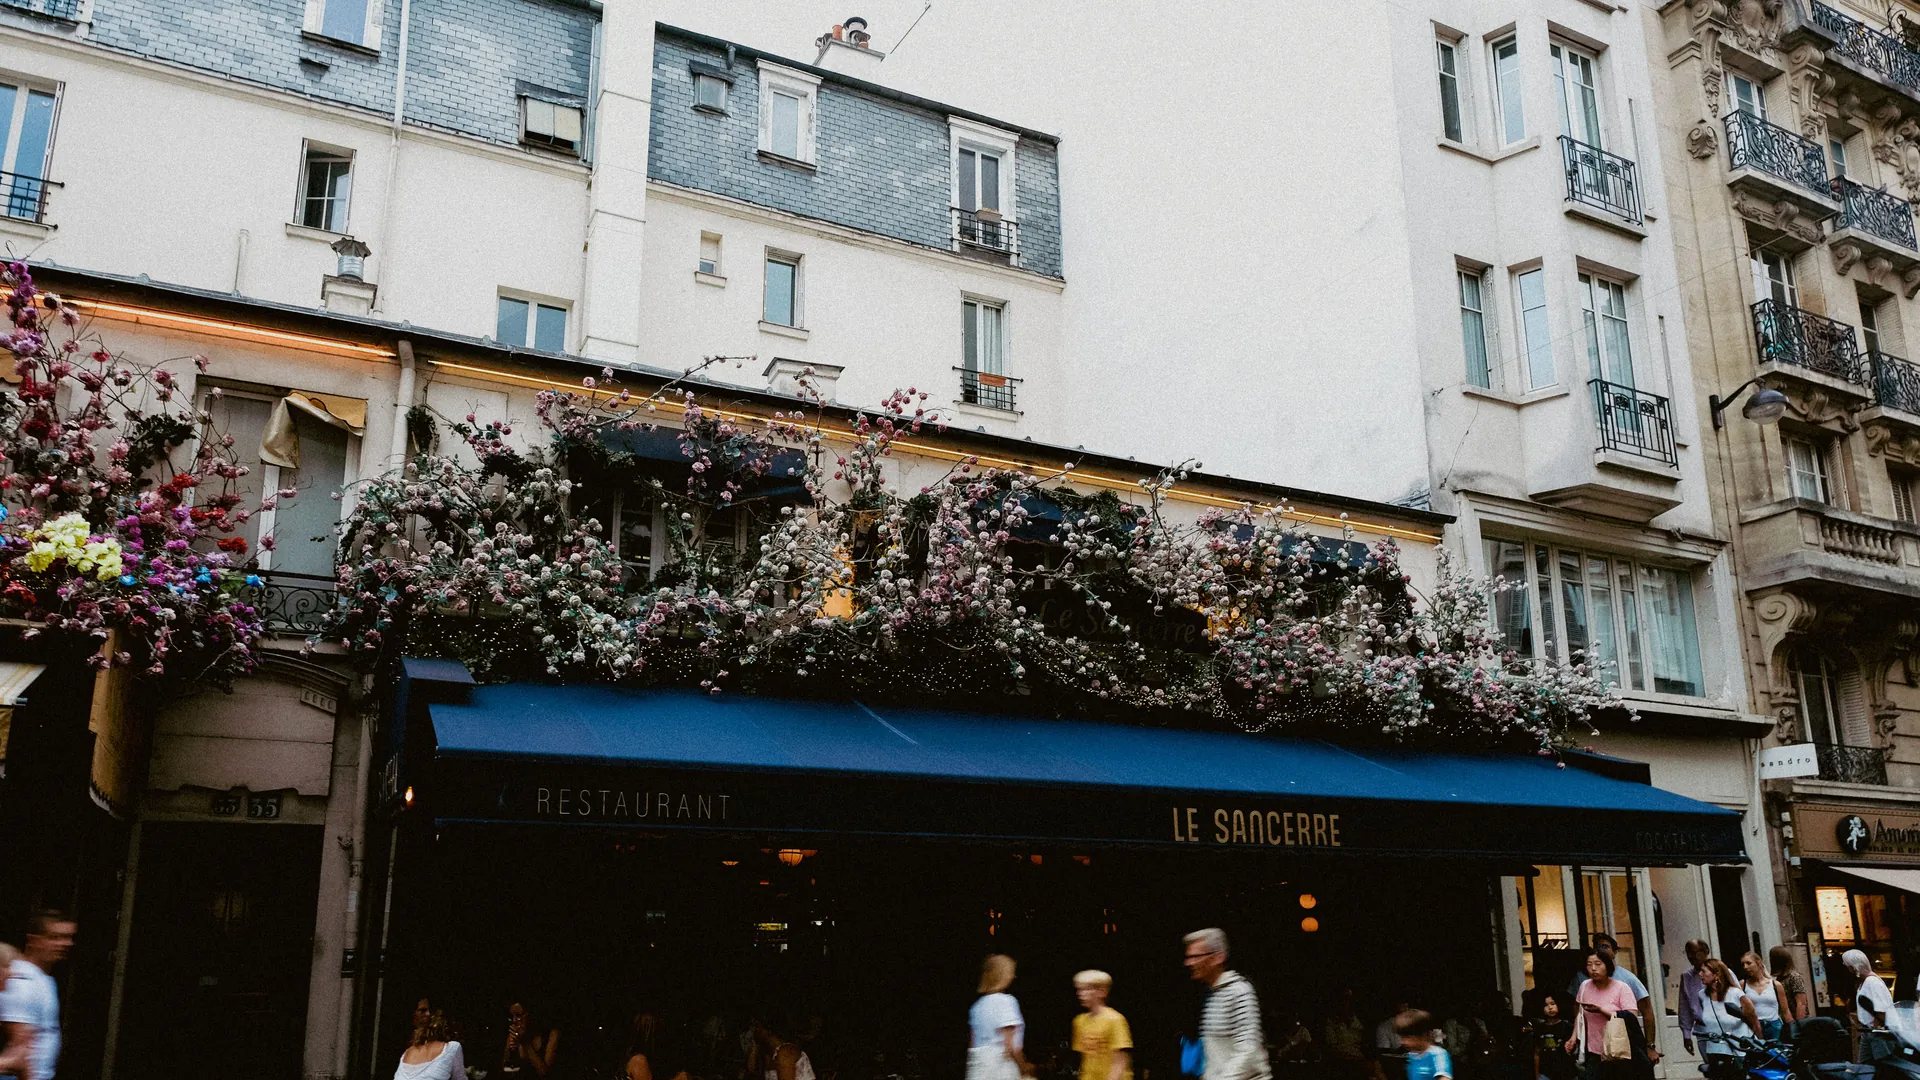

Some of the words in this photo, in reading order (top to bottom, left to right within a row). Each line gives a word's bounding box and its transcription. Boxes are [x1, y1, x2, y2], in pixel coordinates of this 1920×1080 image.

[1038, 598, 1075, 630] Le
[1760, 757, 1811, 768] sandro
[536, 787, 731, 820] RESTAURANT
[1172, 806, 1200, 842] LE
[1213, 807, 1341, 847] SANCERRE
